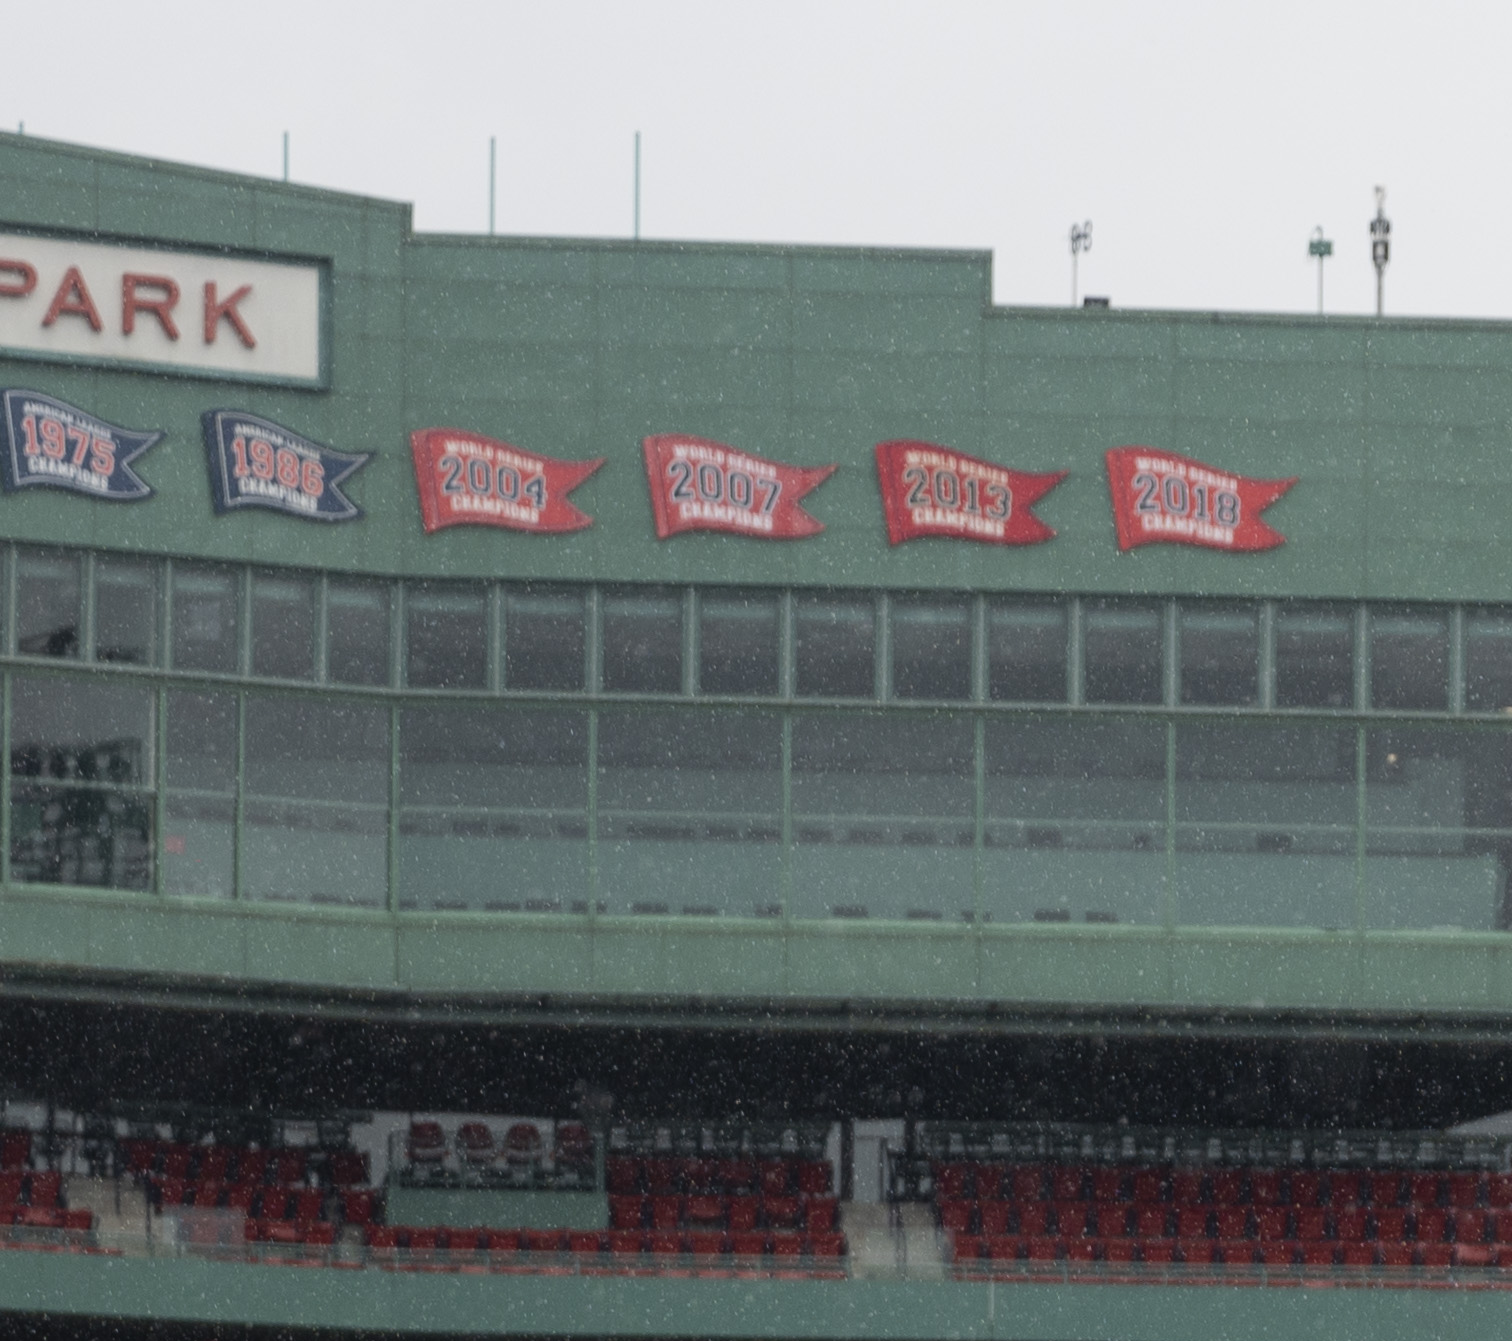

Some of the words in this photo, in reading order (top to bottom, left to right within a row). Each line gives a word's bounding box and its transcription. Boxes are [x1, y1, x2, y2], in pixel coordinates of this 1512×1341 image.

[22, 415, 116, 477] 1975
[232, 436, 325, 498] 1986
[440, 455, 547, 510] 2004
[668, 460, 782, 516] 2007
[903, 466, 1011, 520] 2013
[1133, 473, 1240, 527] 2018
